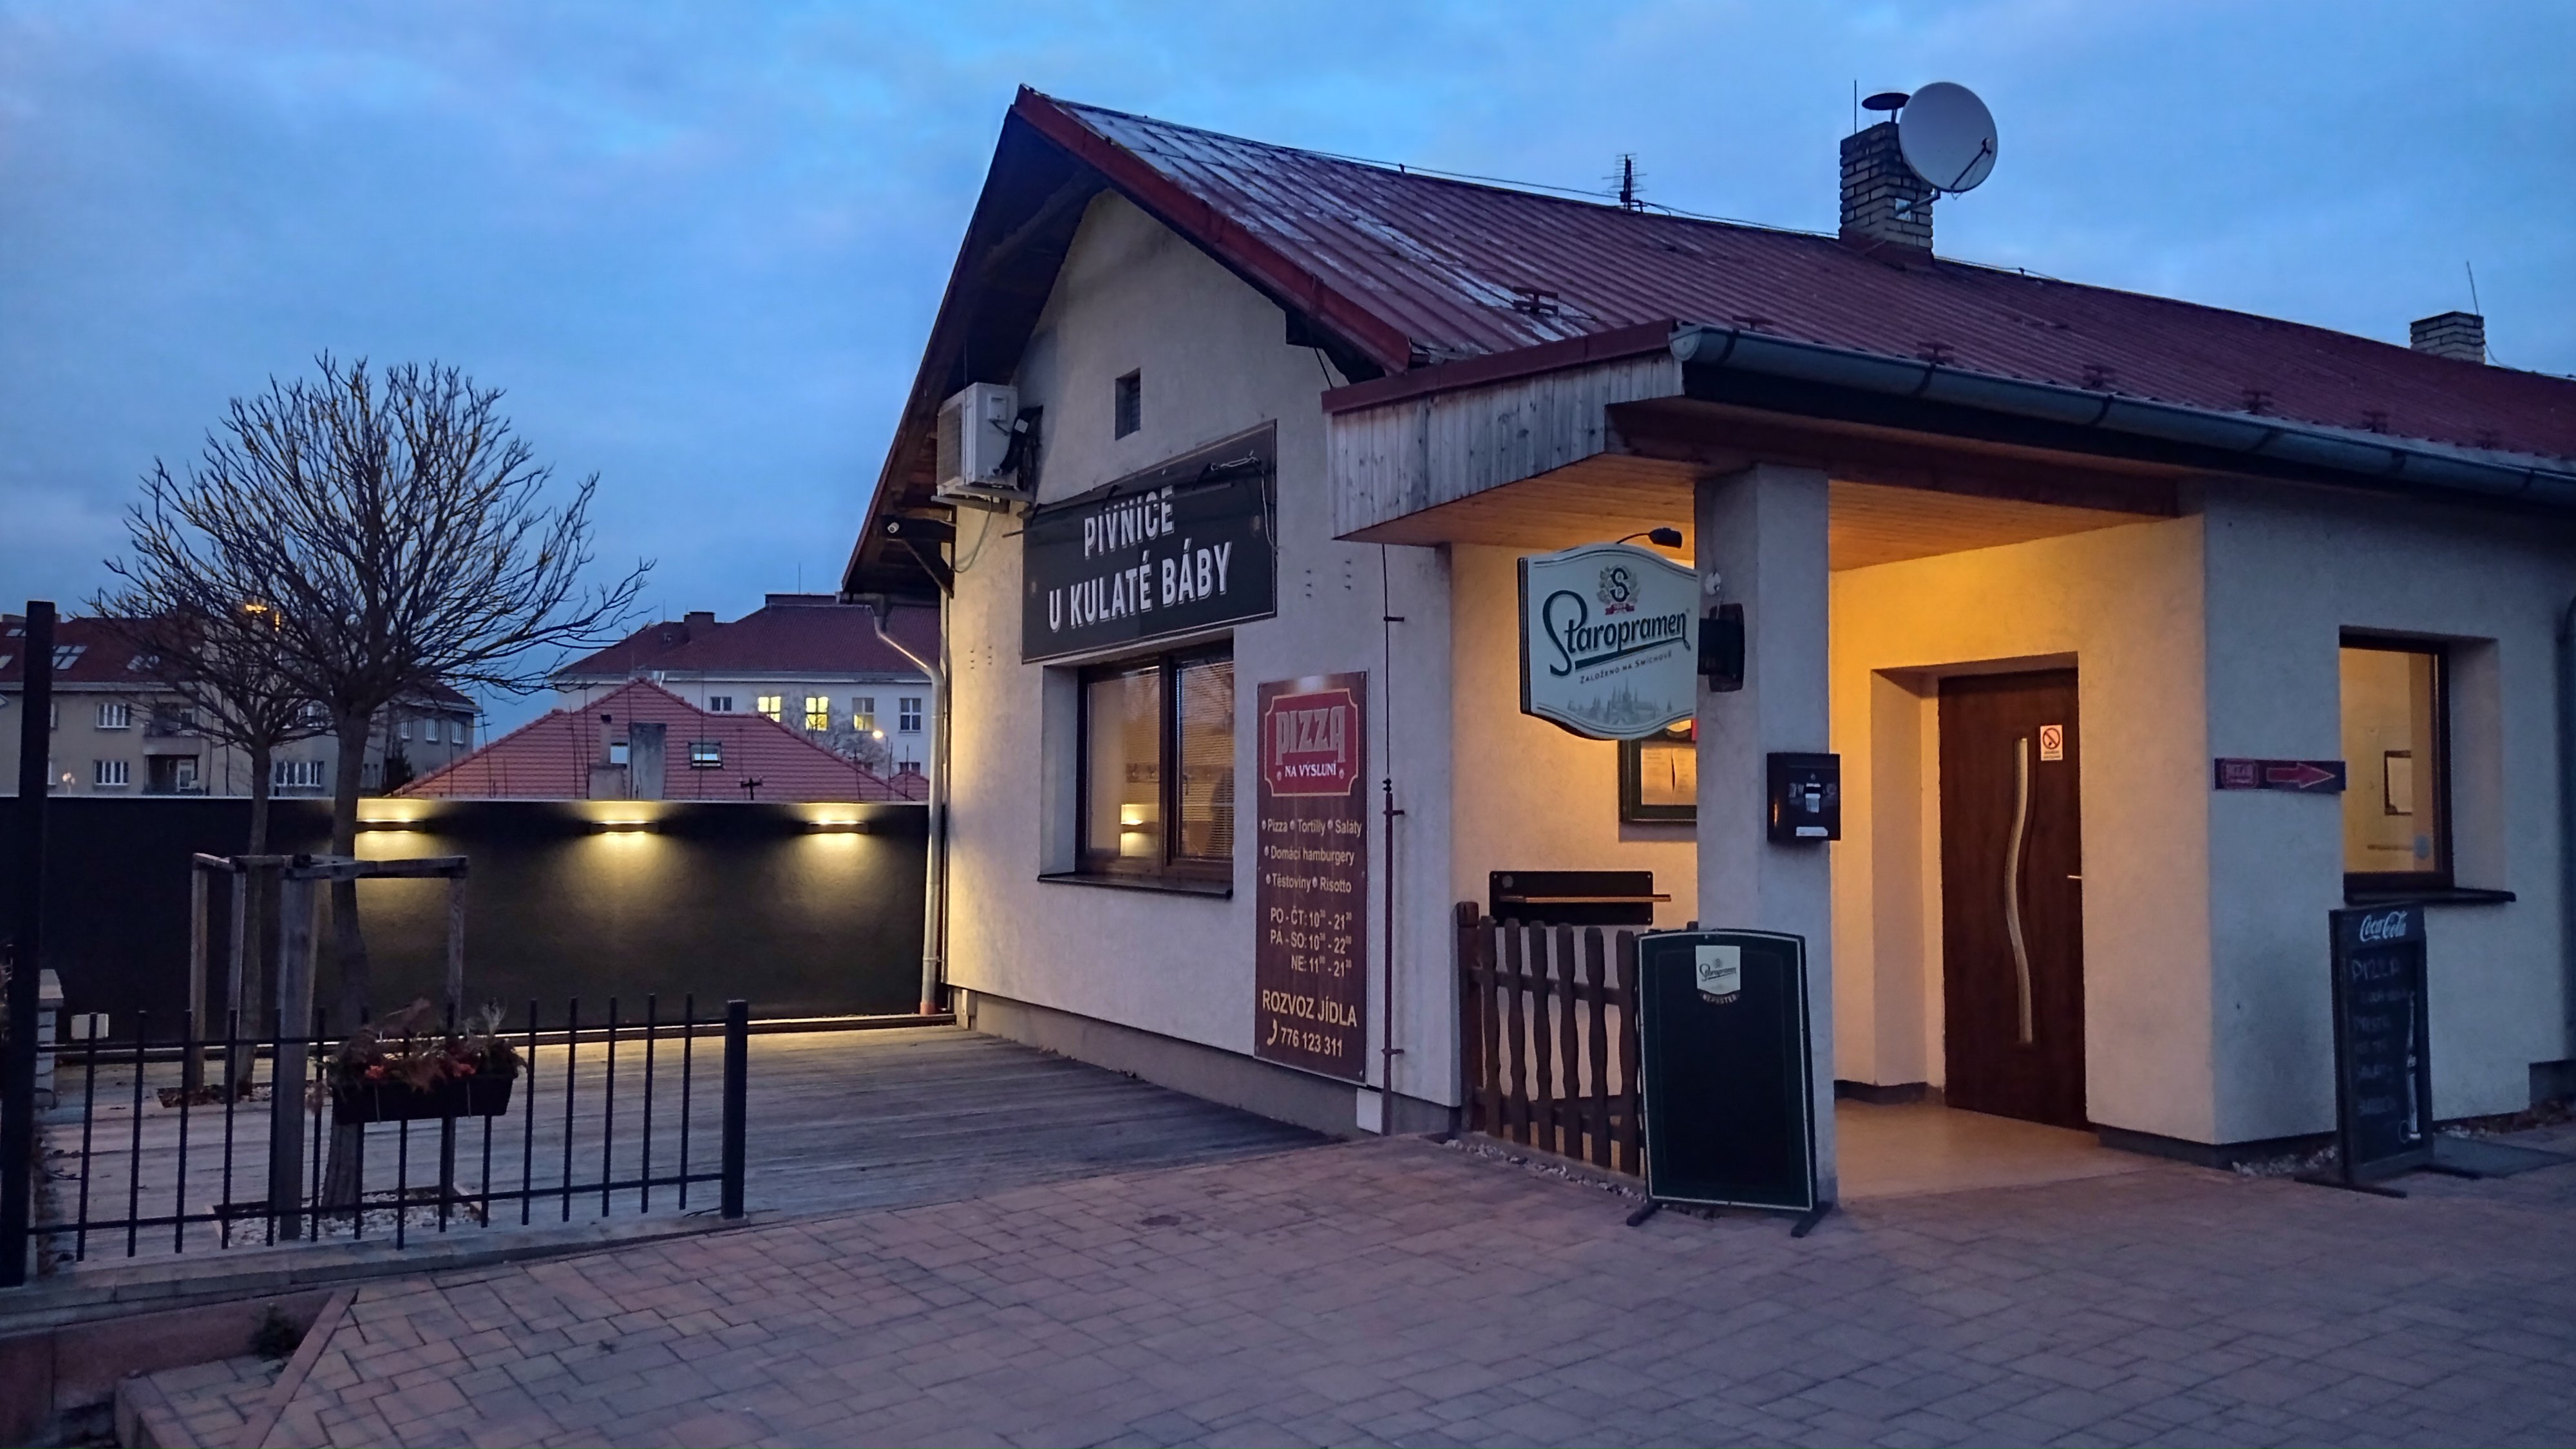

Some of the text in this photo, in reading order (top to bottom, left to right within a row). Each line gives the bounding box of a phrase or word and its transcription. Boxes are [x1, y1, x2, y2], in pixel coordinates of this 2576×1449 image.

[1084, 486, 1174, 560] PIVNICE
[1049, 538, 1232, 632] U KULATÉ BÁBY
[1542, 590, 1691, 676] Staropramen
[1276, 706, 1346, 765] PIZZA
[1285, 760, 1336, 777] NA VÝSLUNÍ
[1267, 818, 1362, 838] Pizza Tortilly Saláty
[1271, 845, 1355, 866] Domácí hamburgery
[1272, 873, 1352, 893] Těstoviny Risotto
[1271, 907, 1284, 923] PO
[1262, 989, 1357, 1027] ROZVOZ JÍDLA
[1281, 1027, 1342, 1057] 776 123 311
